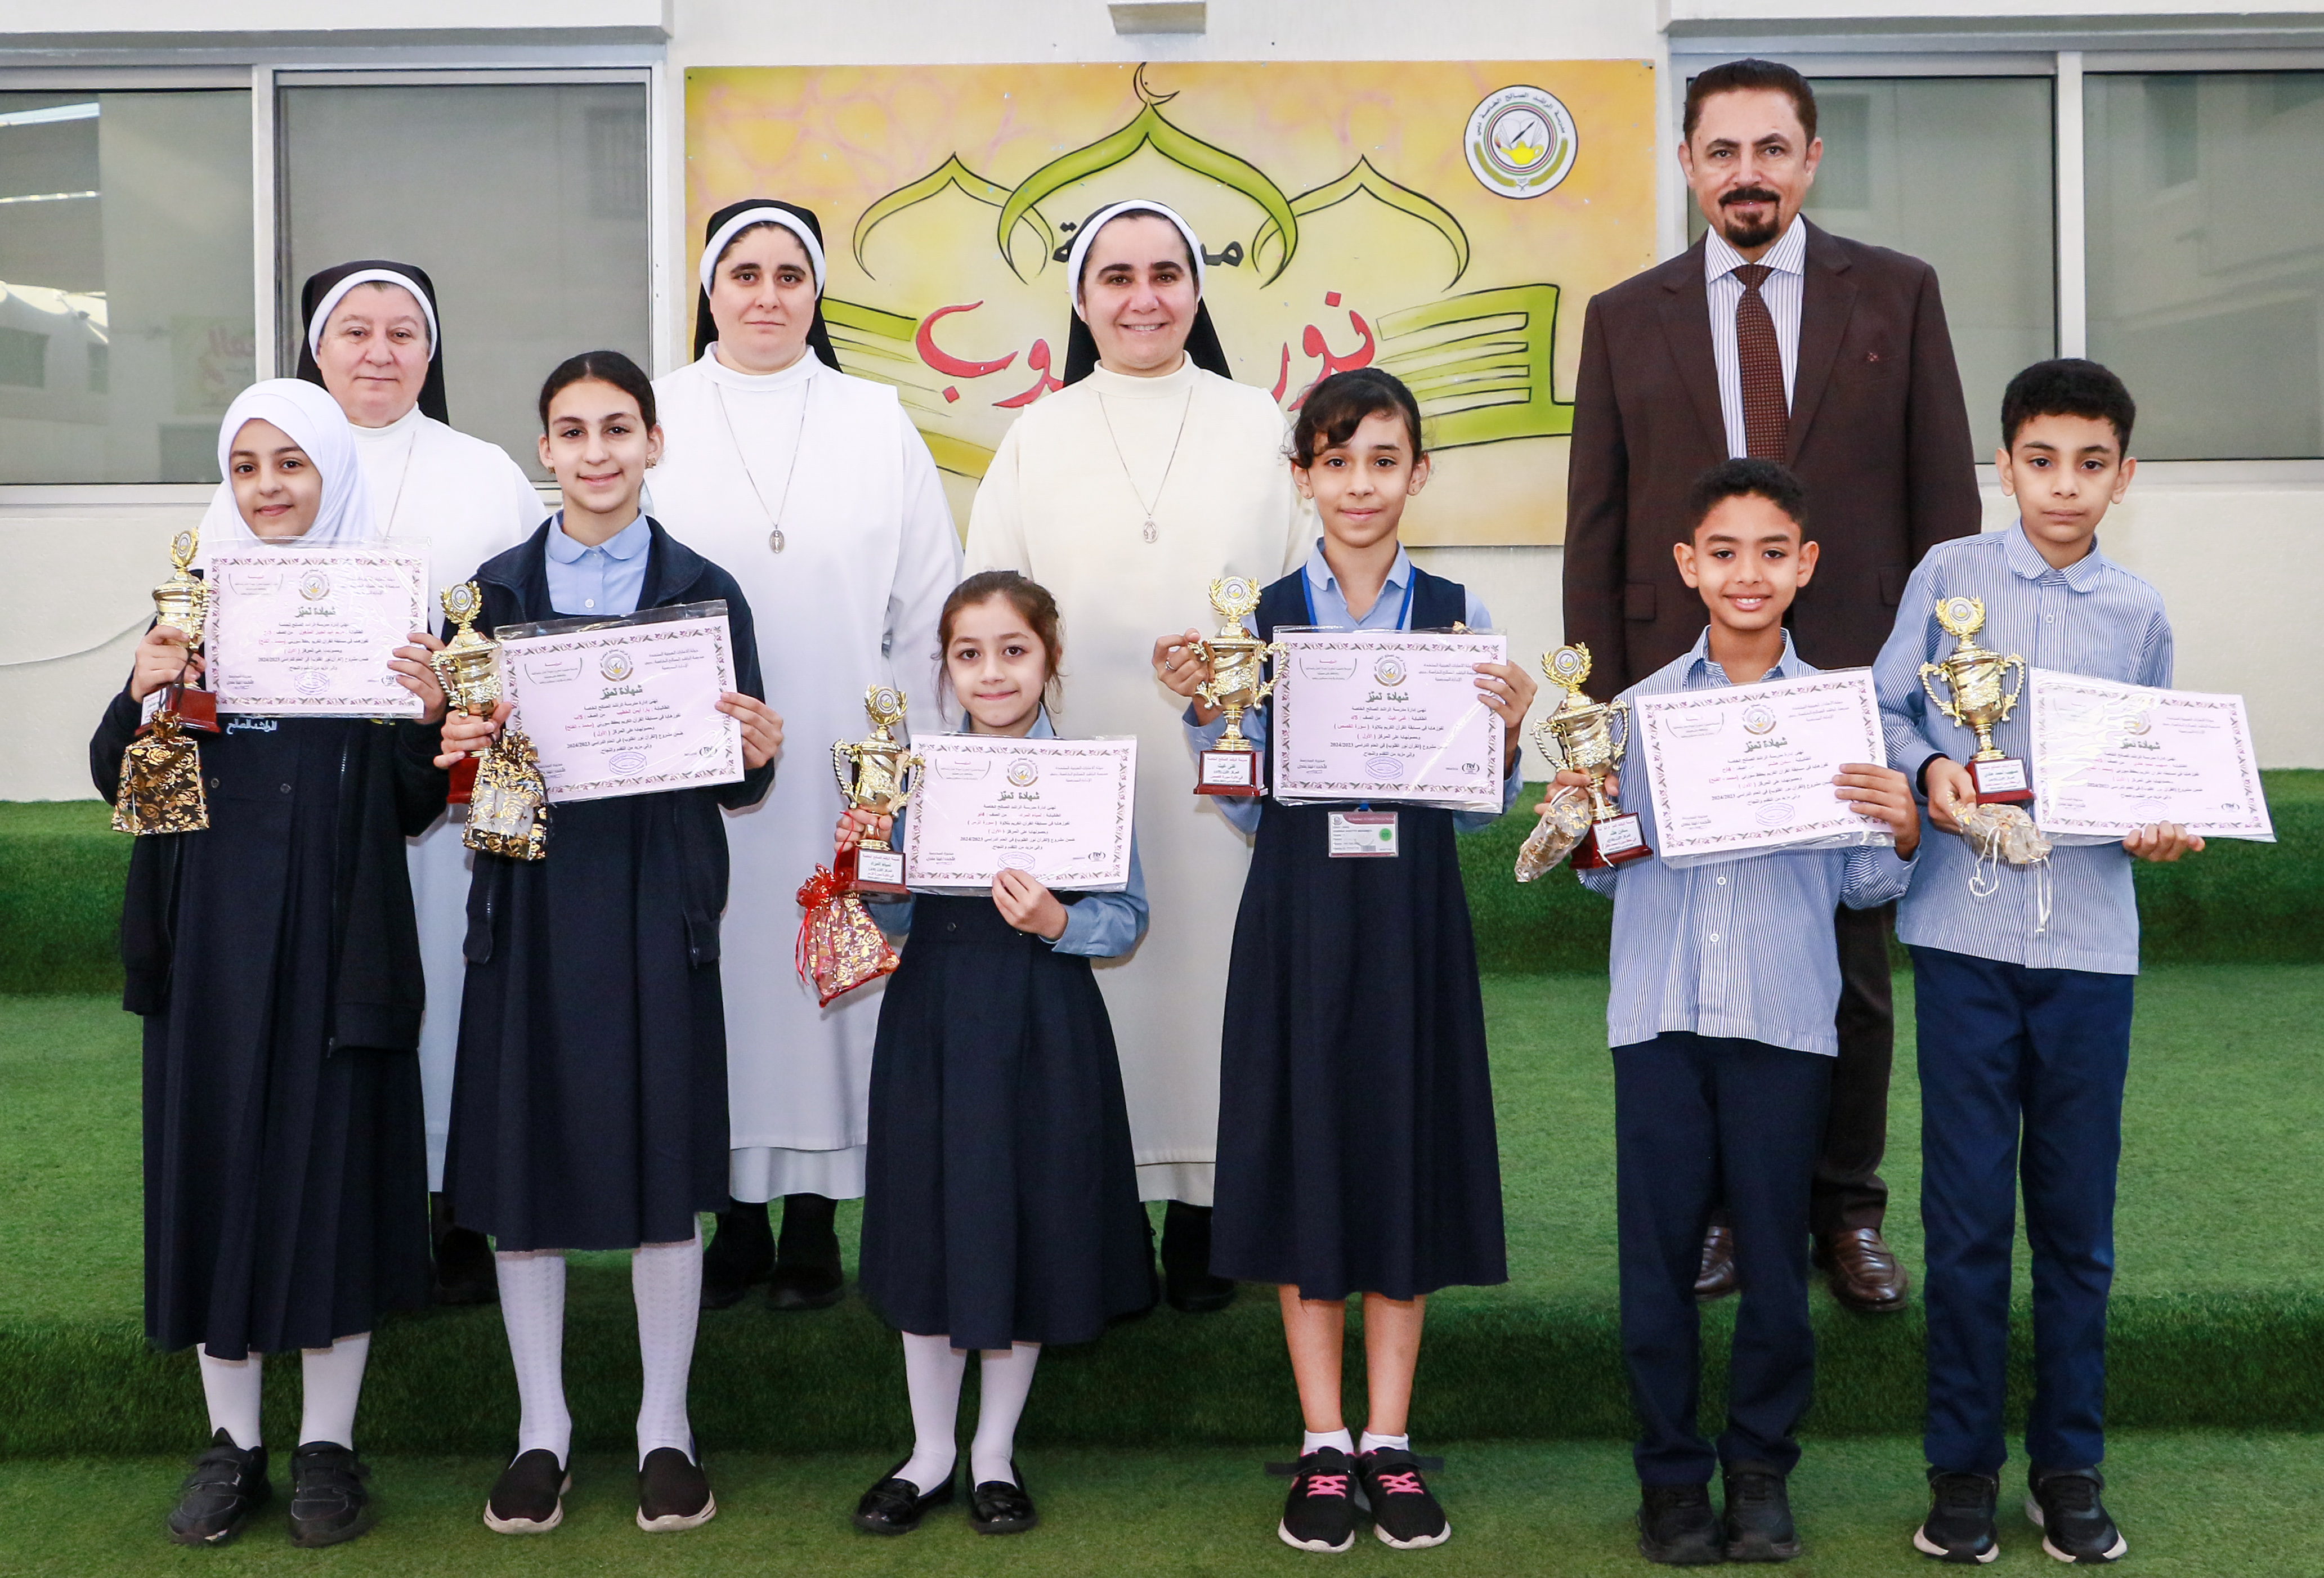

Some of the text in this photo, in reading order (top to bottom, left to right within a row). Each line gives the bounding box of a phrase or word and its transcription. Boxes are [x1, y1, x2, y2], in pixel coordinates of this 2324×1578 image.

[1504, 92, 1529, 102] الصالح
[1533, 95, 1553, 110] الراشد
[1479, 98, 1502, 119] الخاصة
[1554, 110, 1565, 133] مدرسة
[1053, 221, 1244, 267] مدة
[619, 684, 643, 696] شهادة
[1386, 691, 1409, 703] شهادة
[1762, 737, 1788, 748] شهادة
[1018, 791, 1040, 802] شهادة
